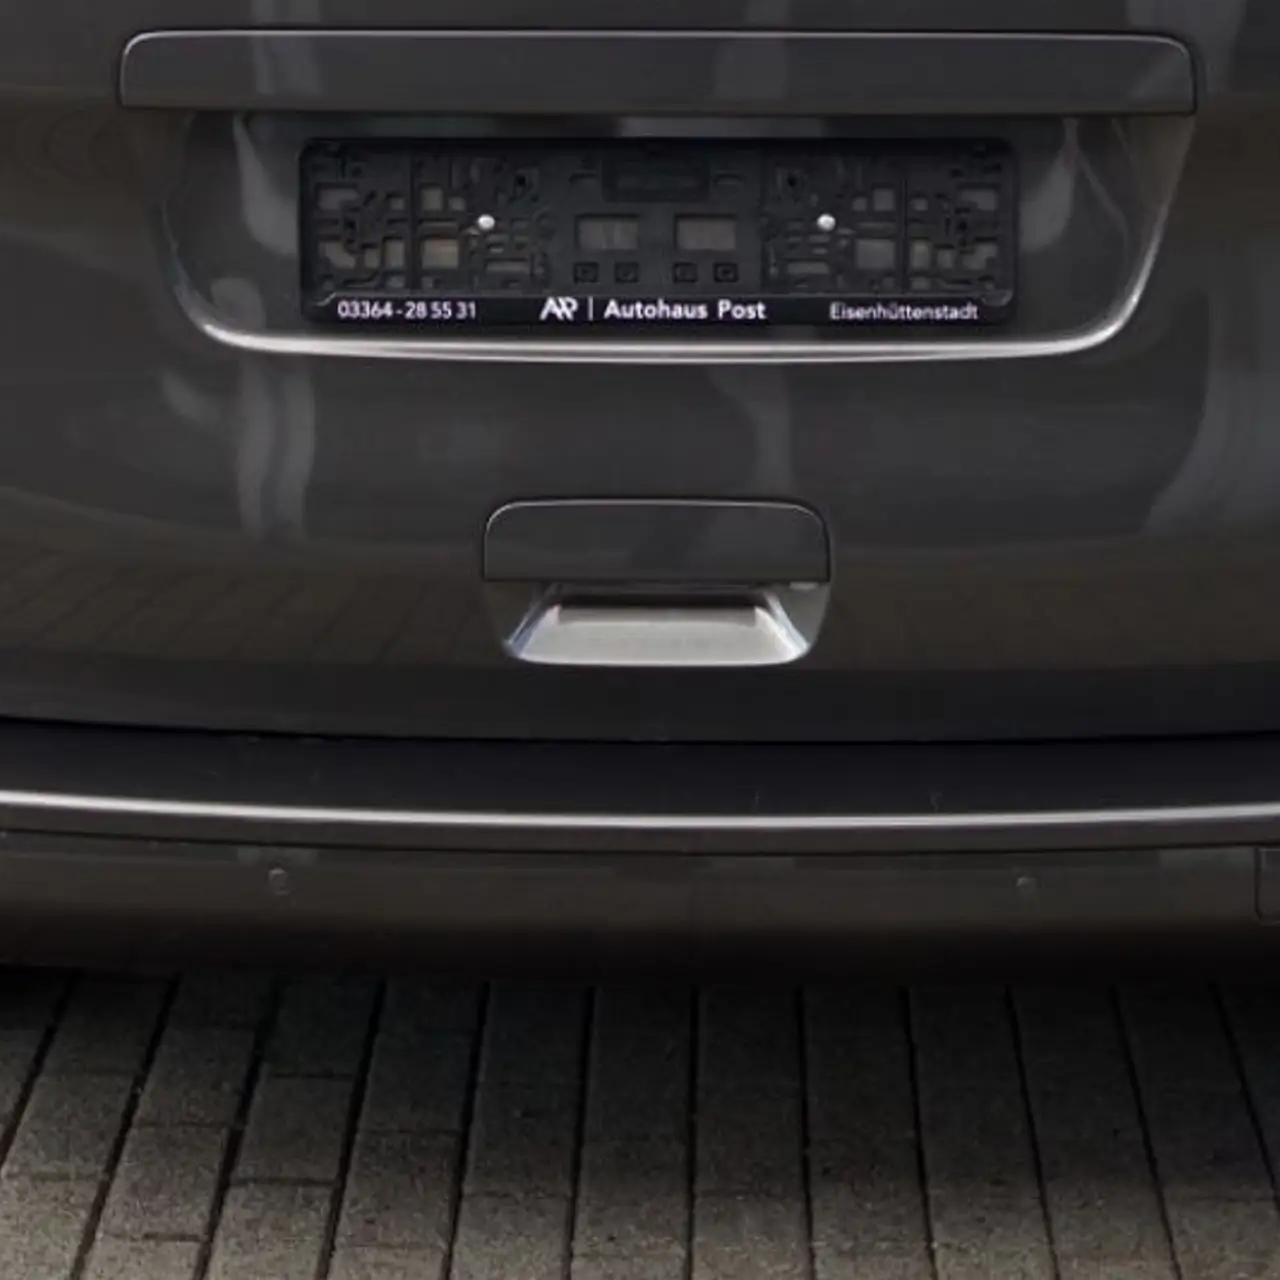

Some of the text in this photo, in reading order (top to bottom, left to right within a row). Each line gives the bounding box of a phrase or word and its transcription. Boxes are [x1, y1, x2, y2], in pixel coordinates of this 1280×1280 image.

[603, 298, 708, 320] Autohaus
[716, 298, 767, 320] Post
[829, 301, 979, 320] Eisenhüttenstadt
